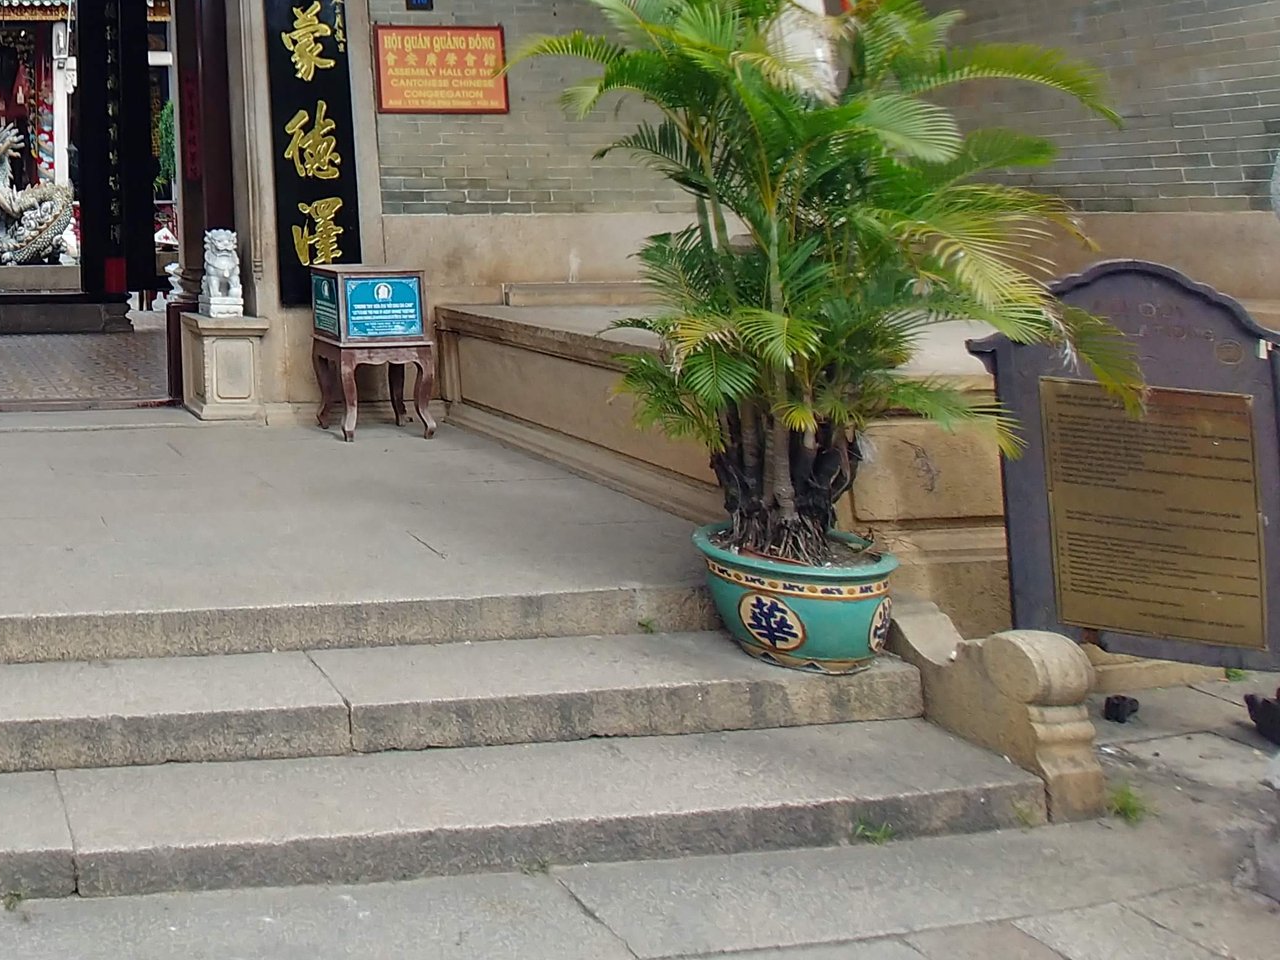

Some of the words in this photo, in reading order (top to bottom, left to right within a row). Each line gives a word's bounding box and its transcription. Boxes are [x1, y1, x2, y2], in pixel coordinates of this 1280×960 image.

[384, 32, 402, 51] HỘI
[433, 31, 466, 53] QUẢNG
[468, 33, 496, 50] ĐÔNG
[387, 67, 437, 77] ASSEMBLY
[439, 67, 463, 77] HALL
[464, 68, 477, 77] OF
[390, 78, 450, 88] CANTONESE
[451, 79, 496, 88] CHINESE
[403, 89, 484, 99] CONGREGATION
